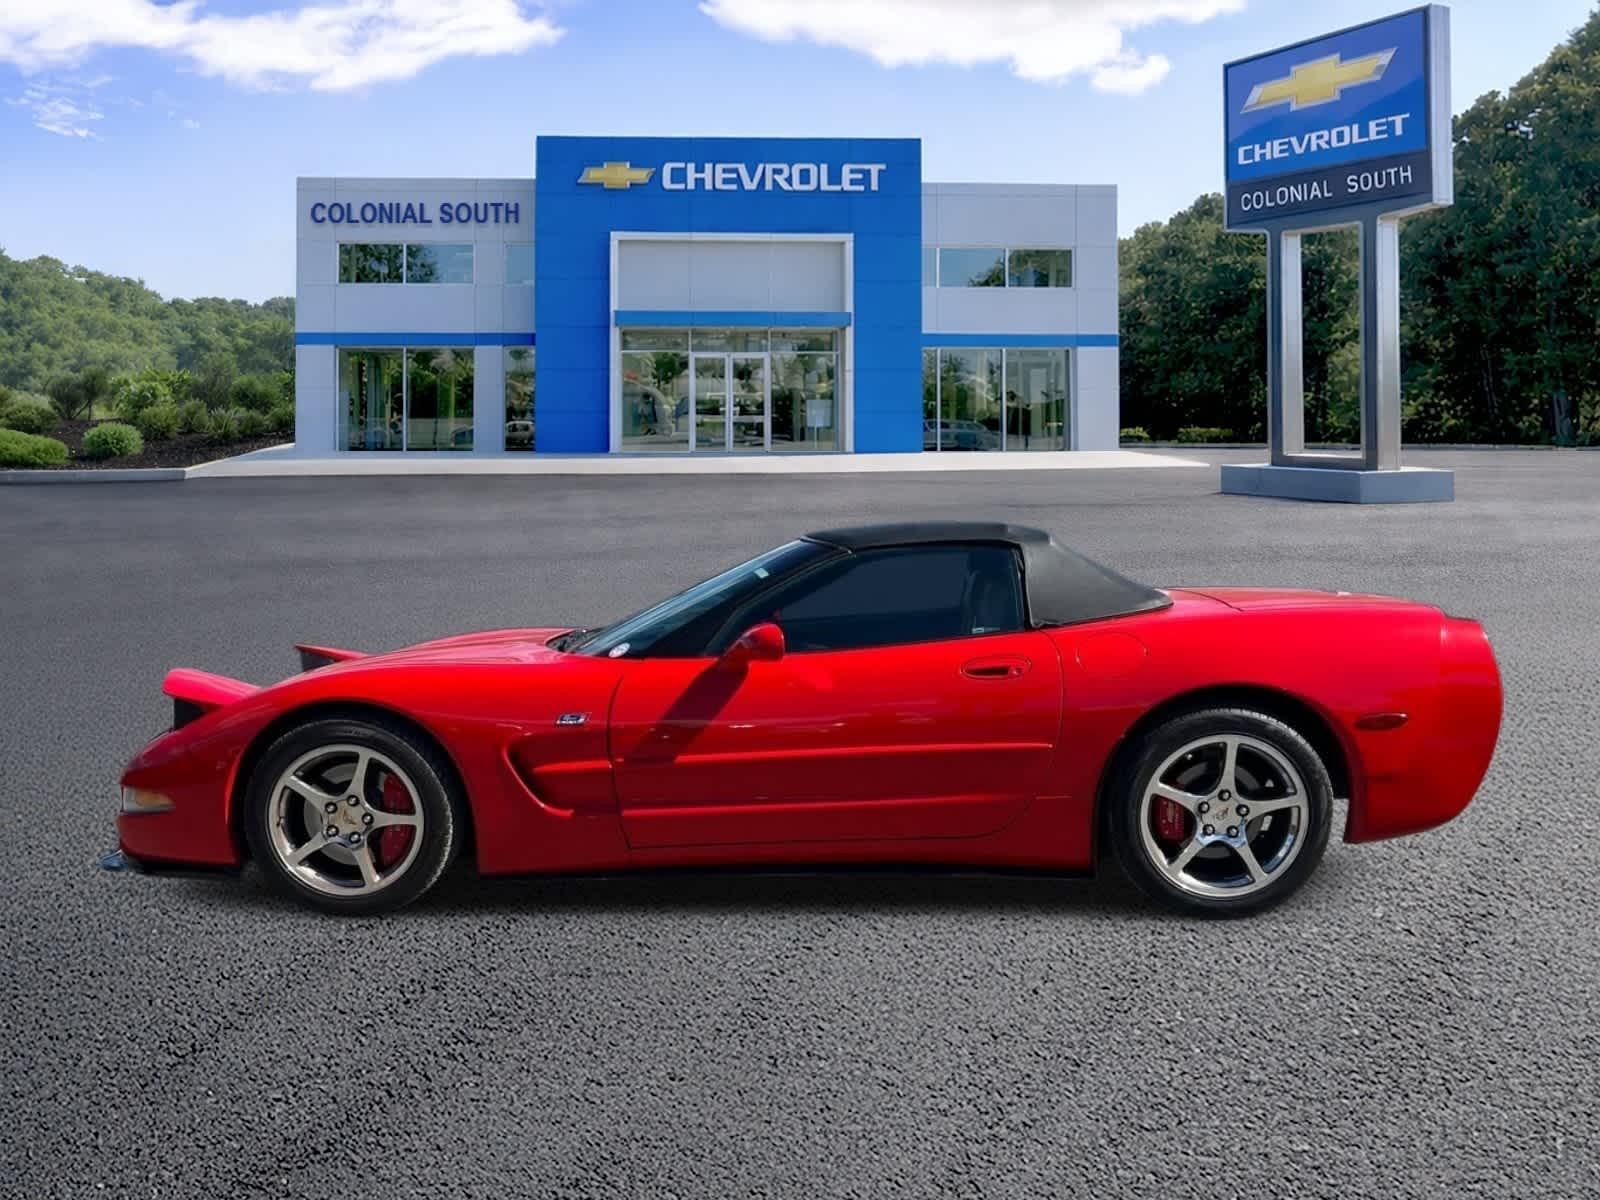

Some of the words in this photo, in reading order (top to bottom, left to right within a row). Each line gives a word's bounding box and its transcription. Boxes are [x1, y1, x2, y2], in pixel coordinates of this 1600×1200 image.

[1238, 113, 1410, 165] CHEVROLET
[661, 162, 887, 192] CHEVROLET
[1241, 180, 1333, 212] COLONIAL
[1346, 165, 1413, 194] SOUTH
[310, 202, 433, 225] COLONIAL
[439, 202, 520, 225] SOUTH
